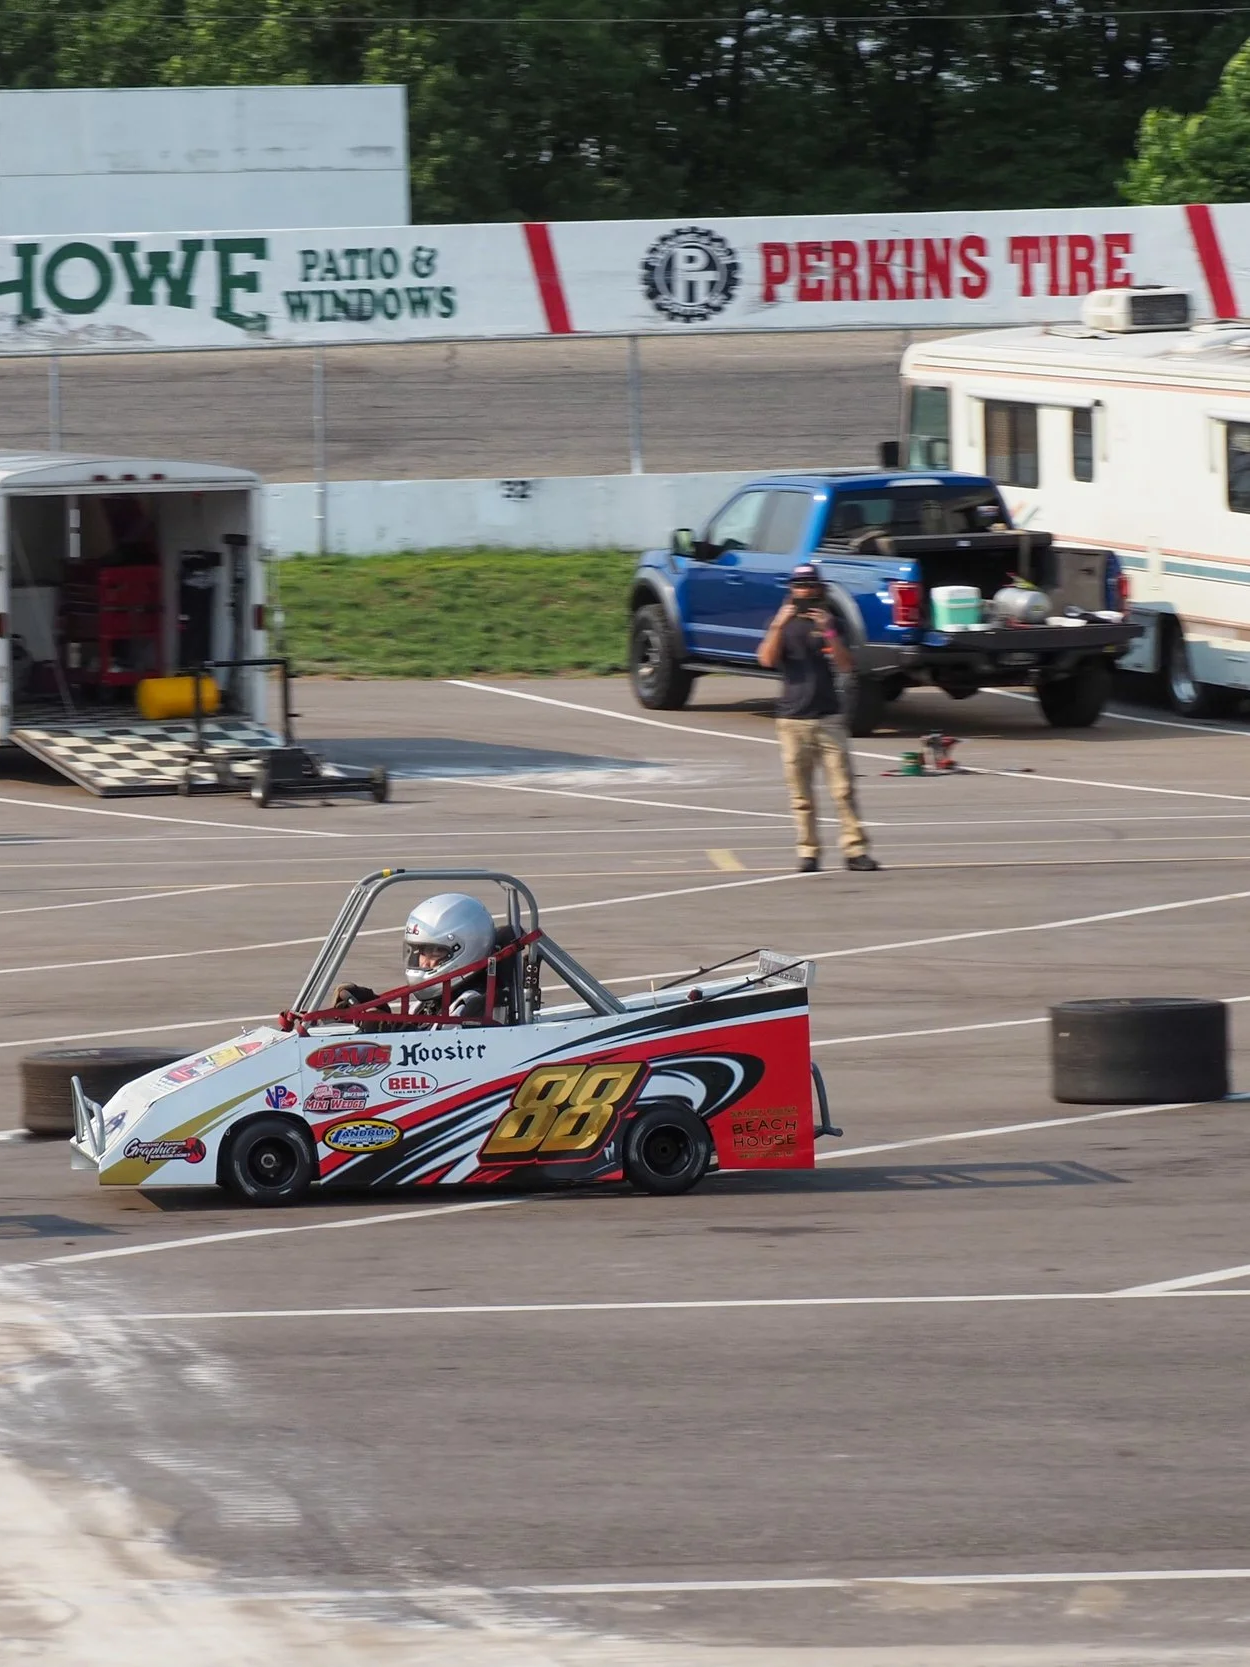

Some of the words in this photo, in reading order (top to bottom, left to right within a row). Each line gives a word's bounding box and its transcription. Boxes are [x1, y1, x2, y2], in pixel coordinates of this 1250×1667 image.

[298, 246, 400, 283] PATIO
[412, 245, 440, 279] &
[759, 235, 989, 303] PERKINS
[1008, 233, 1135, 297] TIRE
[281, 285, 458, 323] WINDOWS
[317, 1046, 391, 1066] DAVIS
[396, 1039, 486, 1067] Hoosier
[388, 1077, 430, 1091] BELL
[304, 1100, 329, 1110] MINI
[481, 1062, 643, 1154] 88
[732, 1119, 797, 1135] BEACH
[733, 1134, 797, 1148] HOUSE
